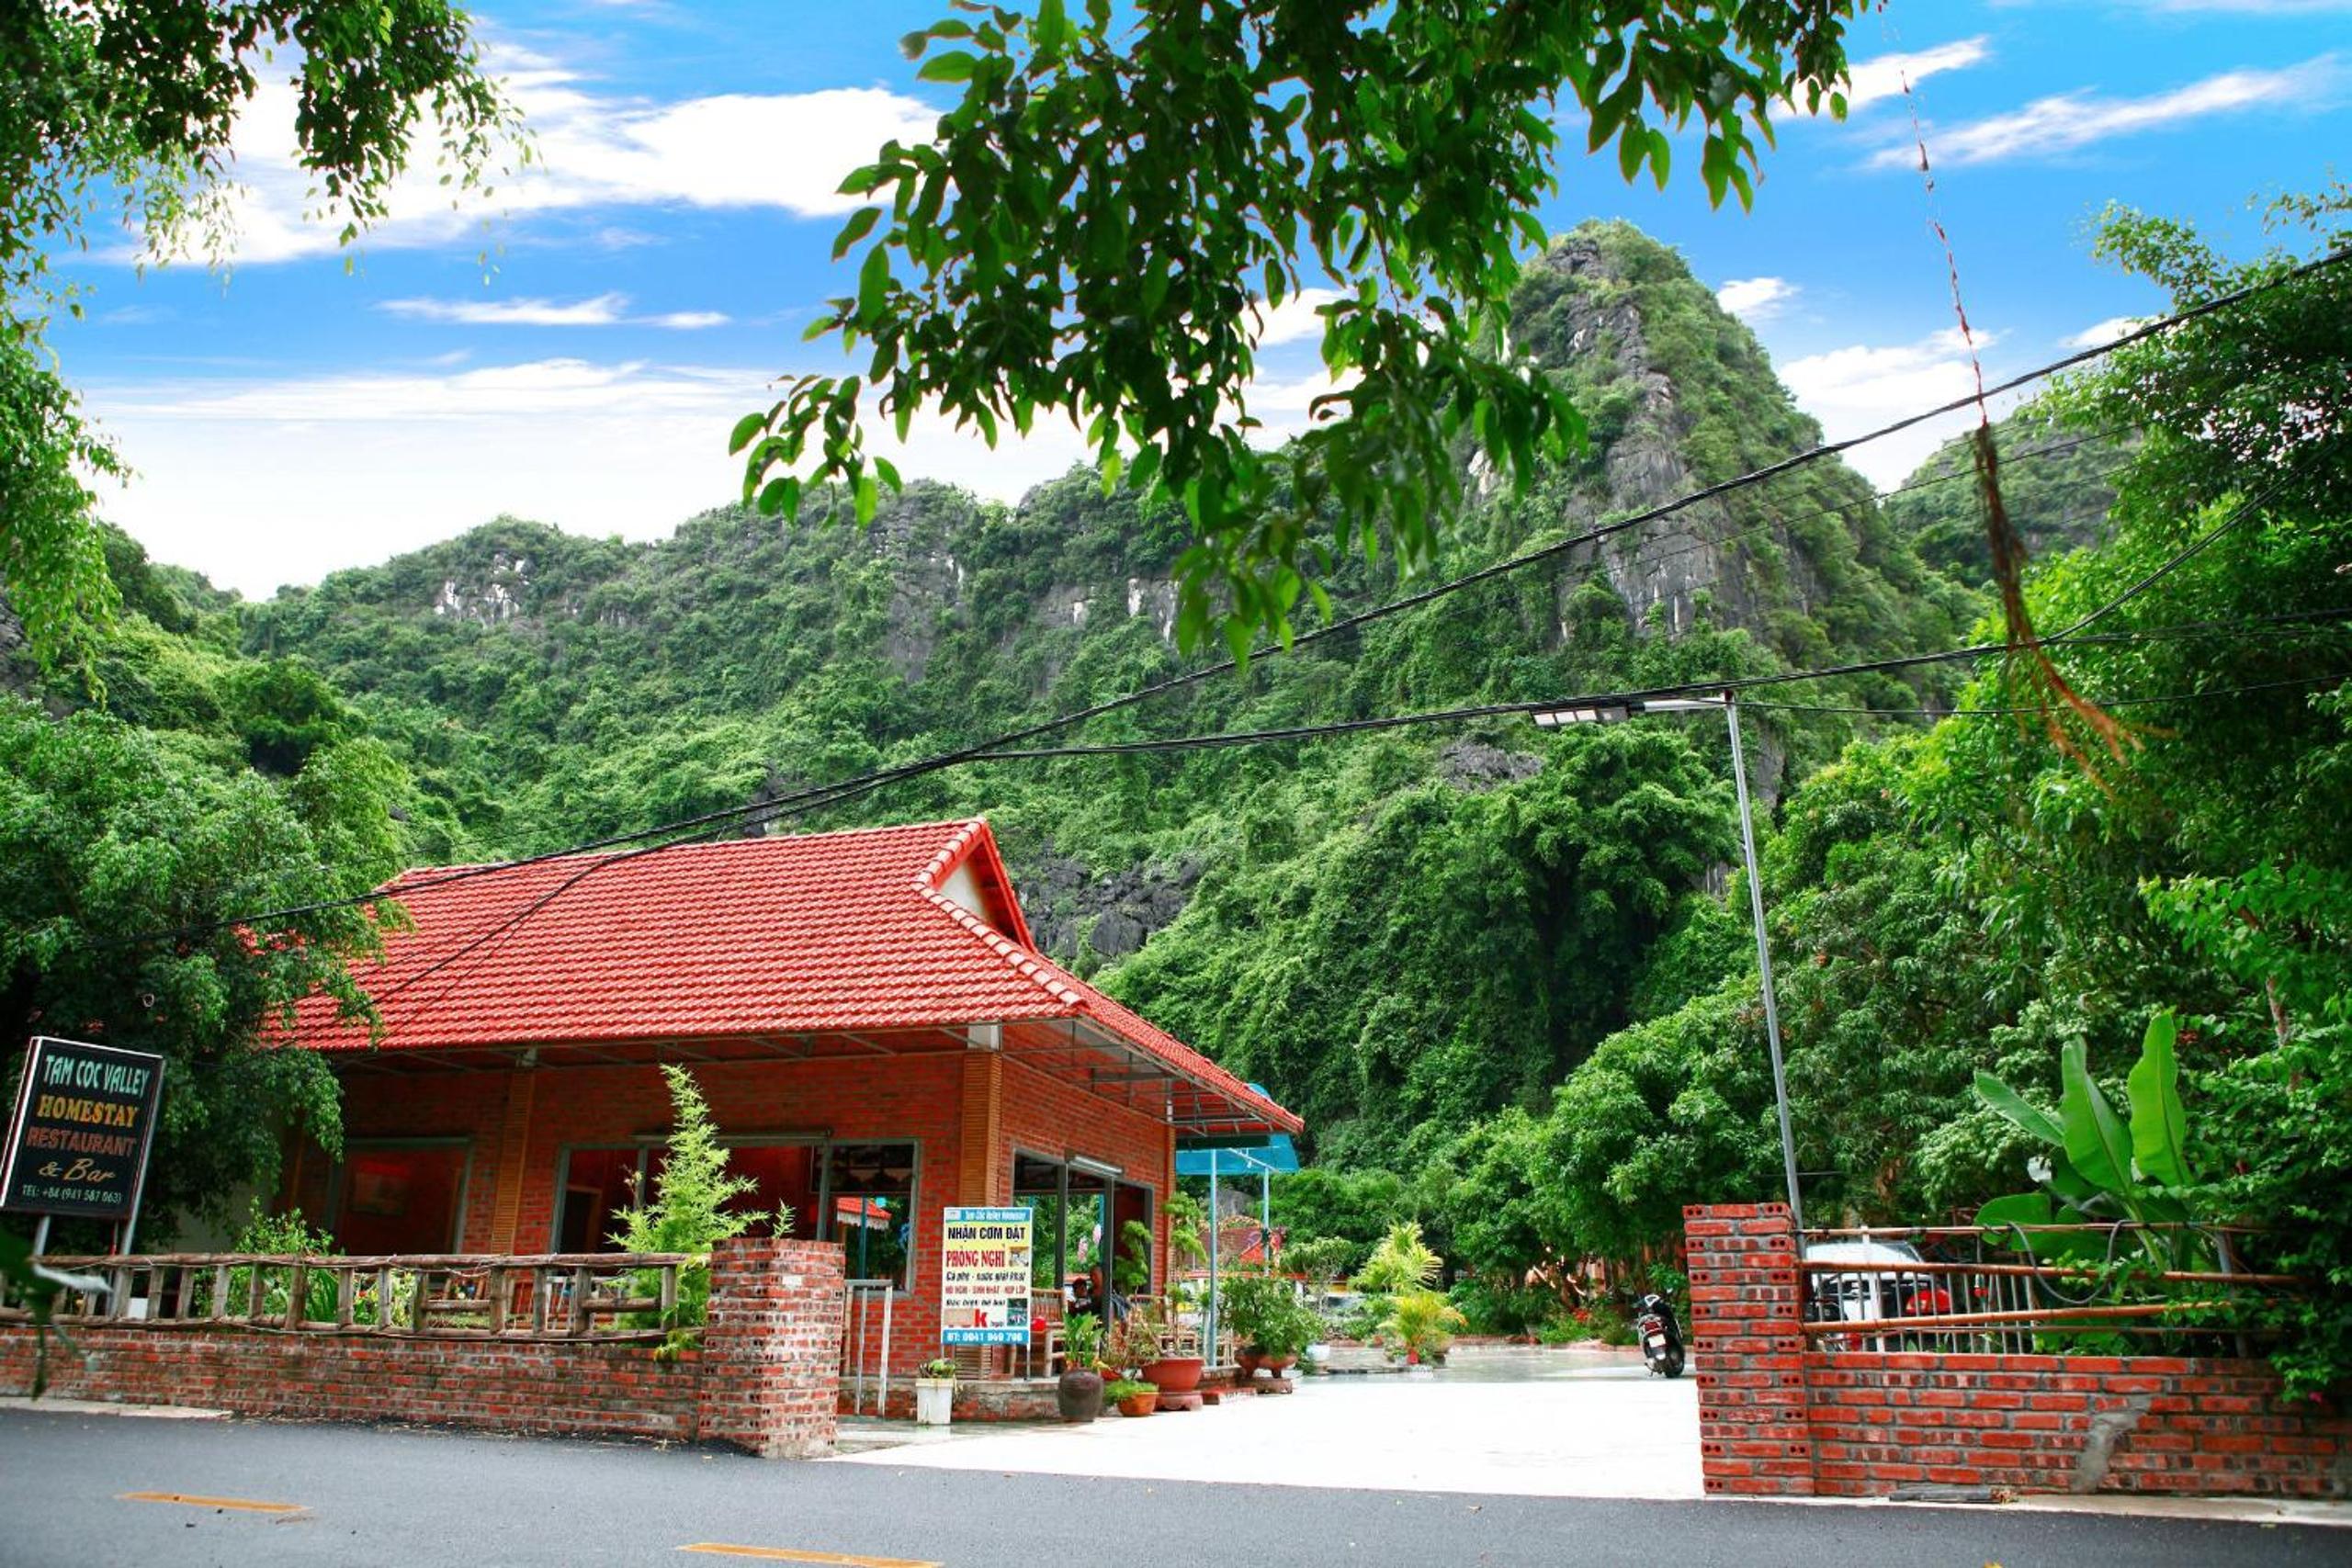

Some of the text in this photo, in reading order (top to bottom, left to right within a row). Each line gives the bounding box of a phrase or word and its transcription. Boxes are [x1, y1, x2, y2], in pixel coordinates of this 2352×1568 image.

[44, 1055, 151, 1099] TAM COC VALLEY
[37, 1094, 139, 1128] HOMESTAY
[26, 1126, 137, 1157] RESTAURANT
[39, 1158, 117, 1182] & Bar
[948, 1224, 977, 1242] NHẬN
[946, 1246, 978, 1268] PHÒNG
